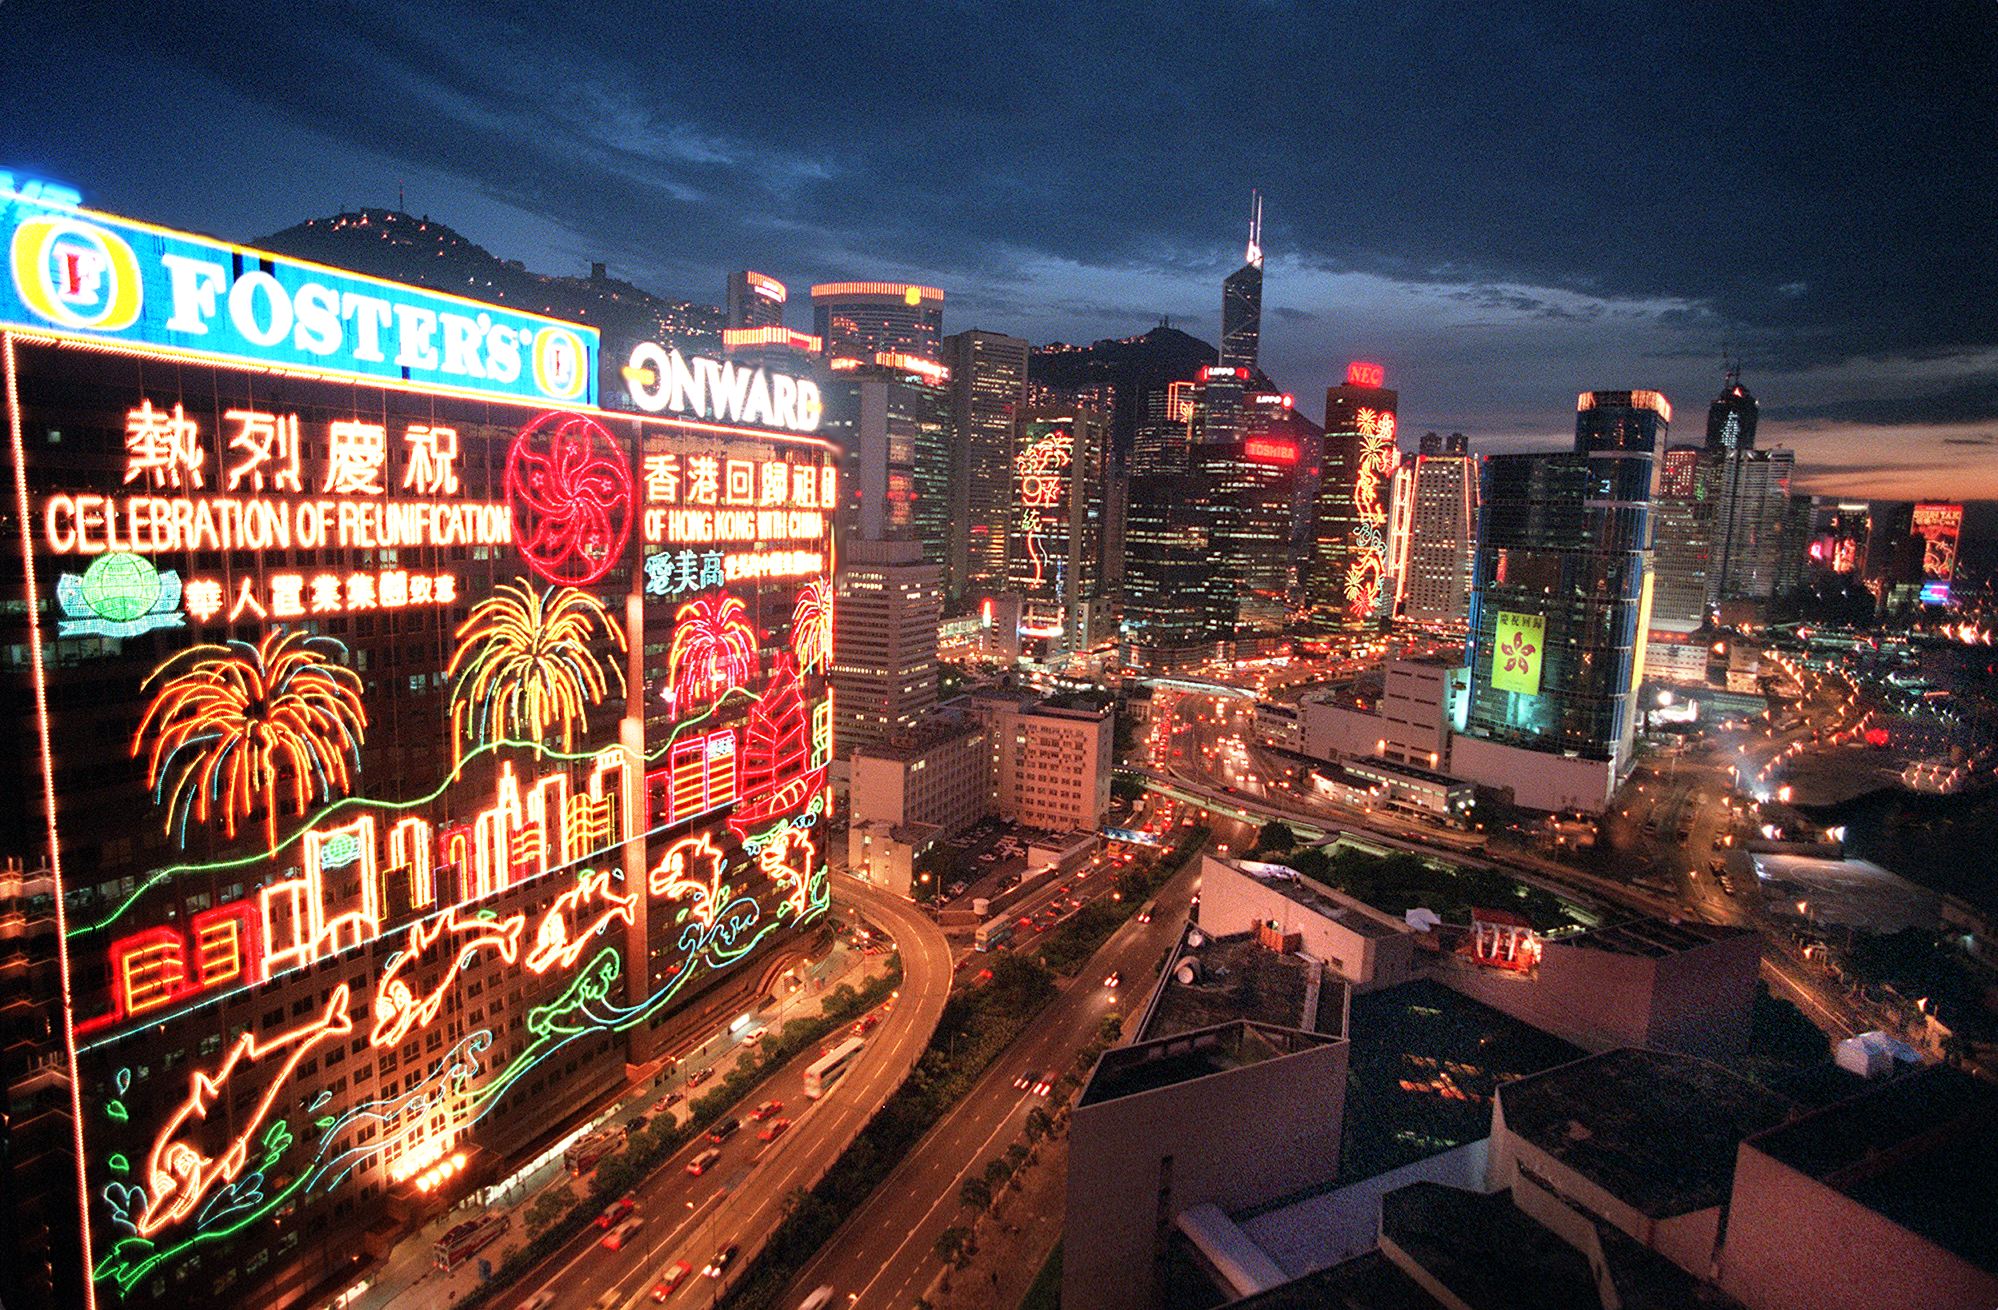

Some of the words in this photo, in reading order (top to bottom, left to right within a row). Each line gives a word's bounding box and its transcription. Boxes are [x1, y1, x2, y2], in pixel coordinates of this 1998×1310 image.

[162, 254, 521, 384] FOSTER'S
[627, 341, 821, 432] ONWARD
[1351, 366, 1380, 384] NEC
[124, 399, 458, 495] 熱烈慶祝
[1249, 443, 1294, 459] TOSHIBA
[46, 494, 291, 554] CELEBRATION
[296, 500, 336, 548] OF
[338, 502, 512, 547] REUNIFICATION
[644, 509, 667, 542] OF
[668, 510, 714, 541] HONG
[714, 511, 755, 540] KONG
[757, 511, 788, 540] WITH
[788, 511, 823, 538] CHINA
[644, 550, 725, 595] 愛美高
